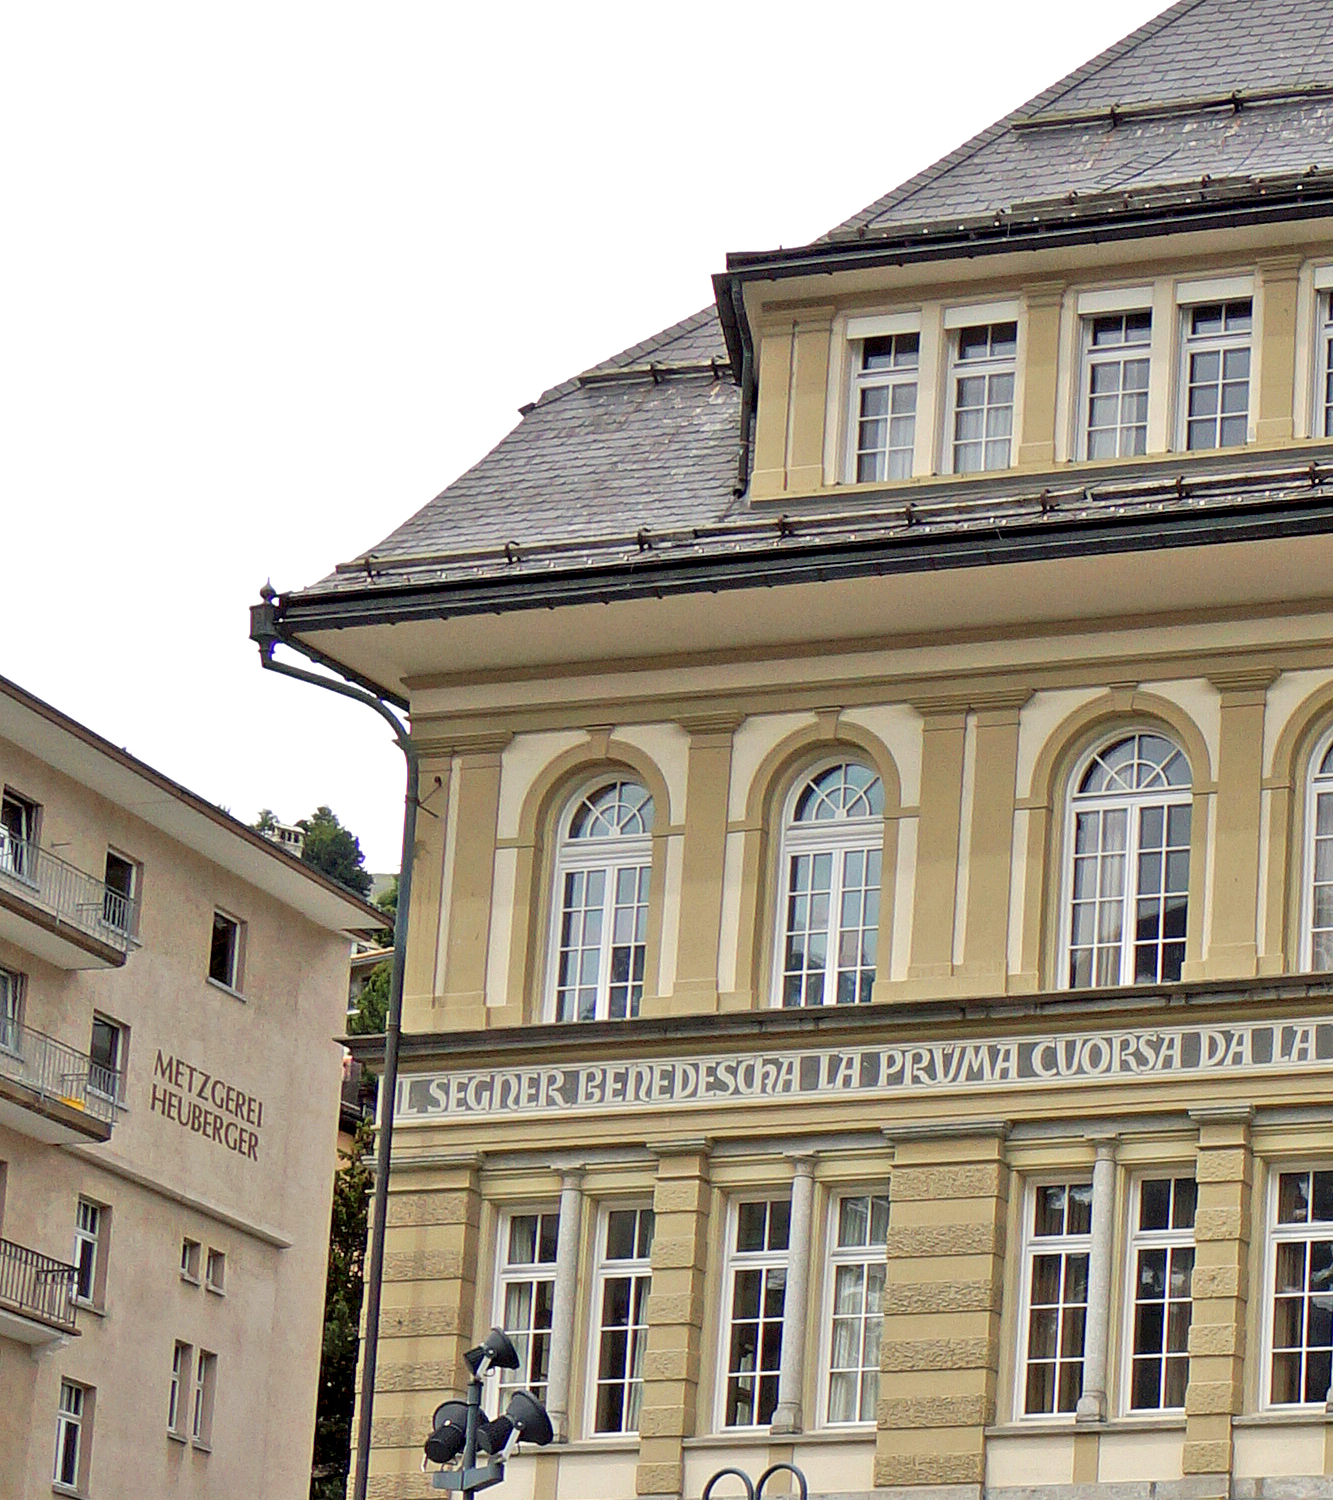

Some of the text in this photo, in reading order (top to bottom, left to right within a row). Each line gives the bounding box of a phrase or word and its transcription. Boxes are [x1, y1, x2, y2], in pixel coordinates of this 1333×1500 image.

[153, 1049, 263, 1128] METZGEREI
[427, 1068, 573, 1113] SEGNER
[577, 1055, 801, 1106] BENEDESCHA
[817, 1052, 862, 1090] LA
[877, 1042, 1019, 1087] PRÜMA
[1031, 1032, 1183, 1077] CUORSA
[1199, 1027, 1254, 1068] DA
[1271, 1024, 1318, 1063] LA
[150, 1082, 259, 1162] HEUBERGER
